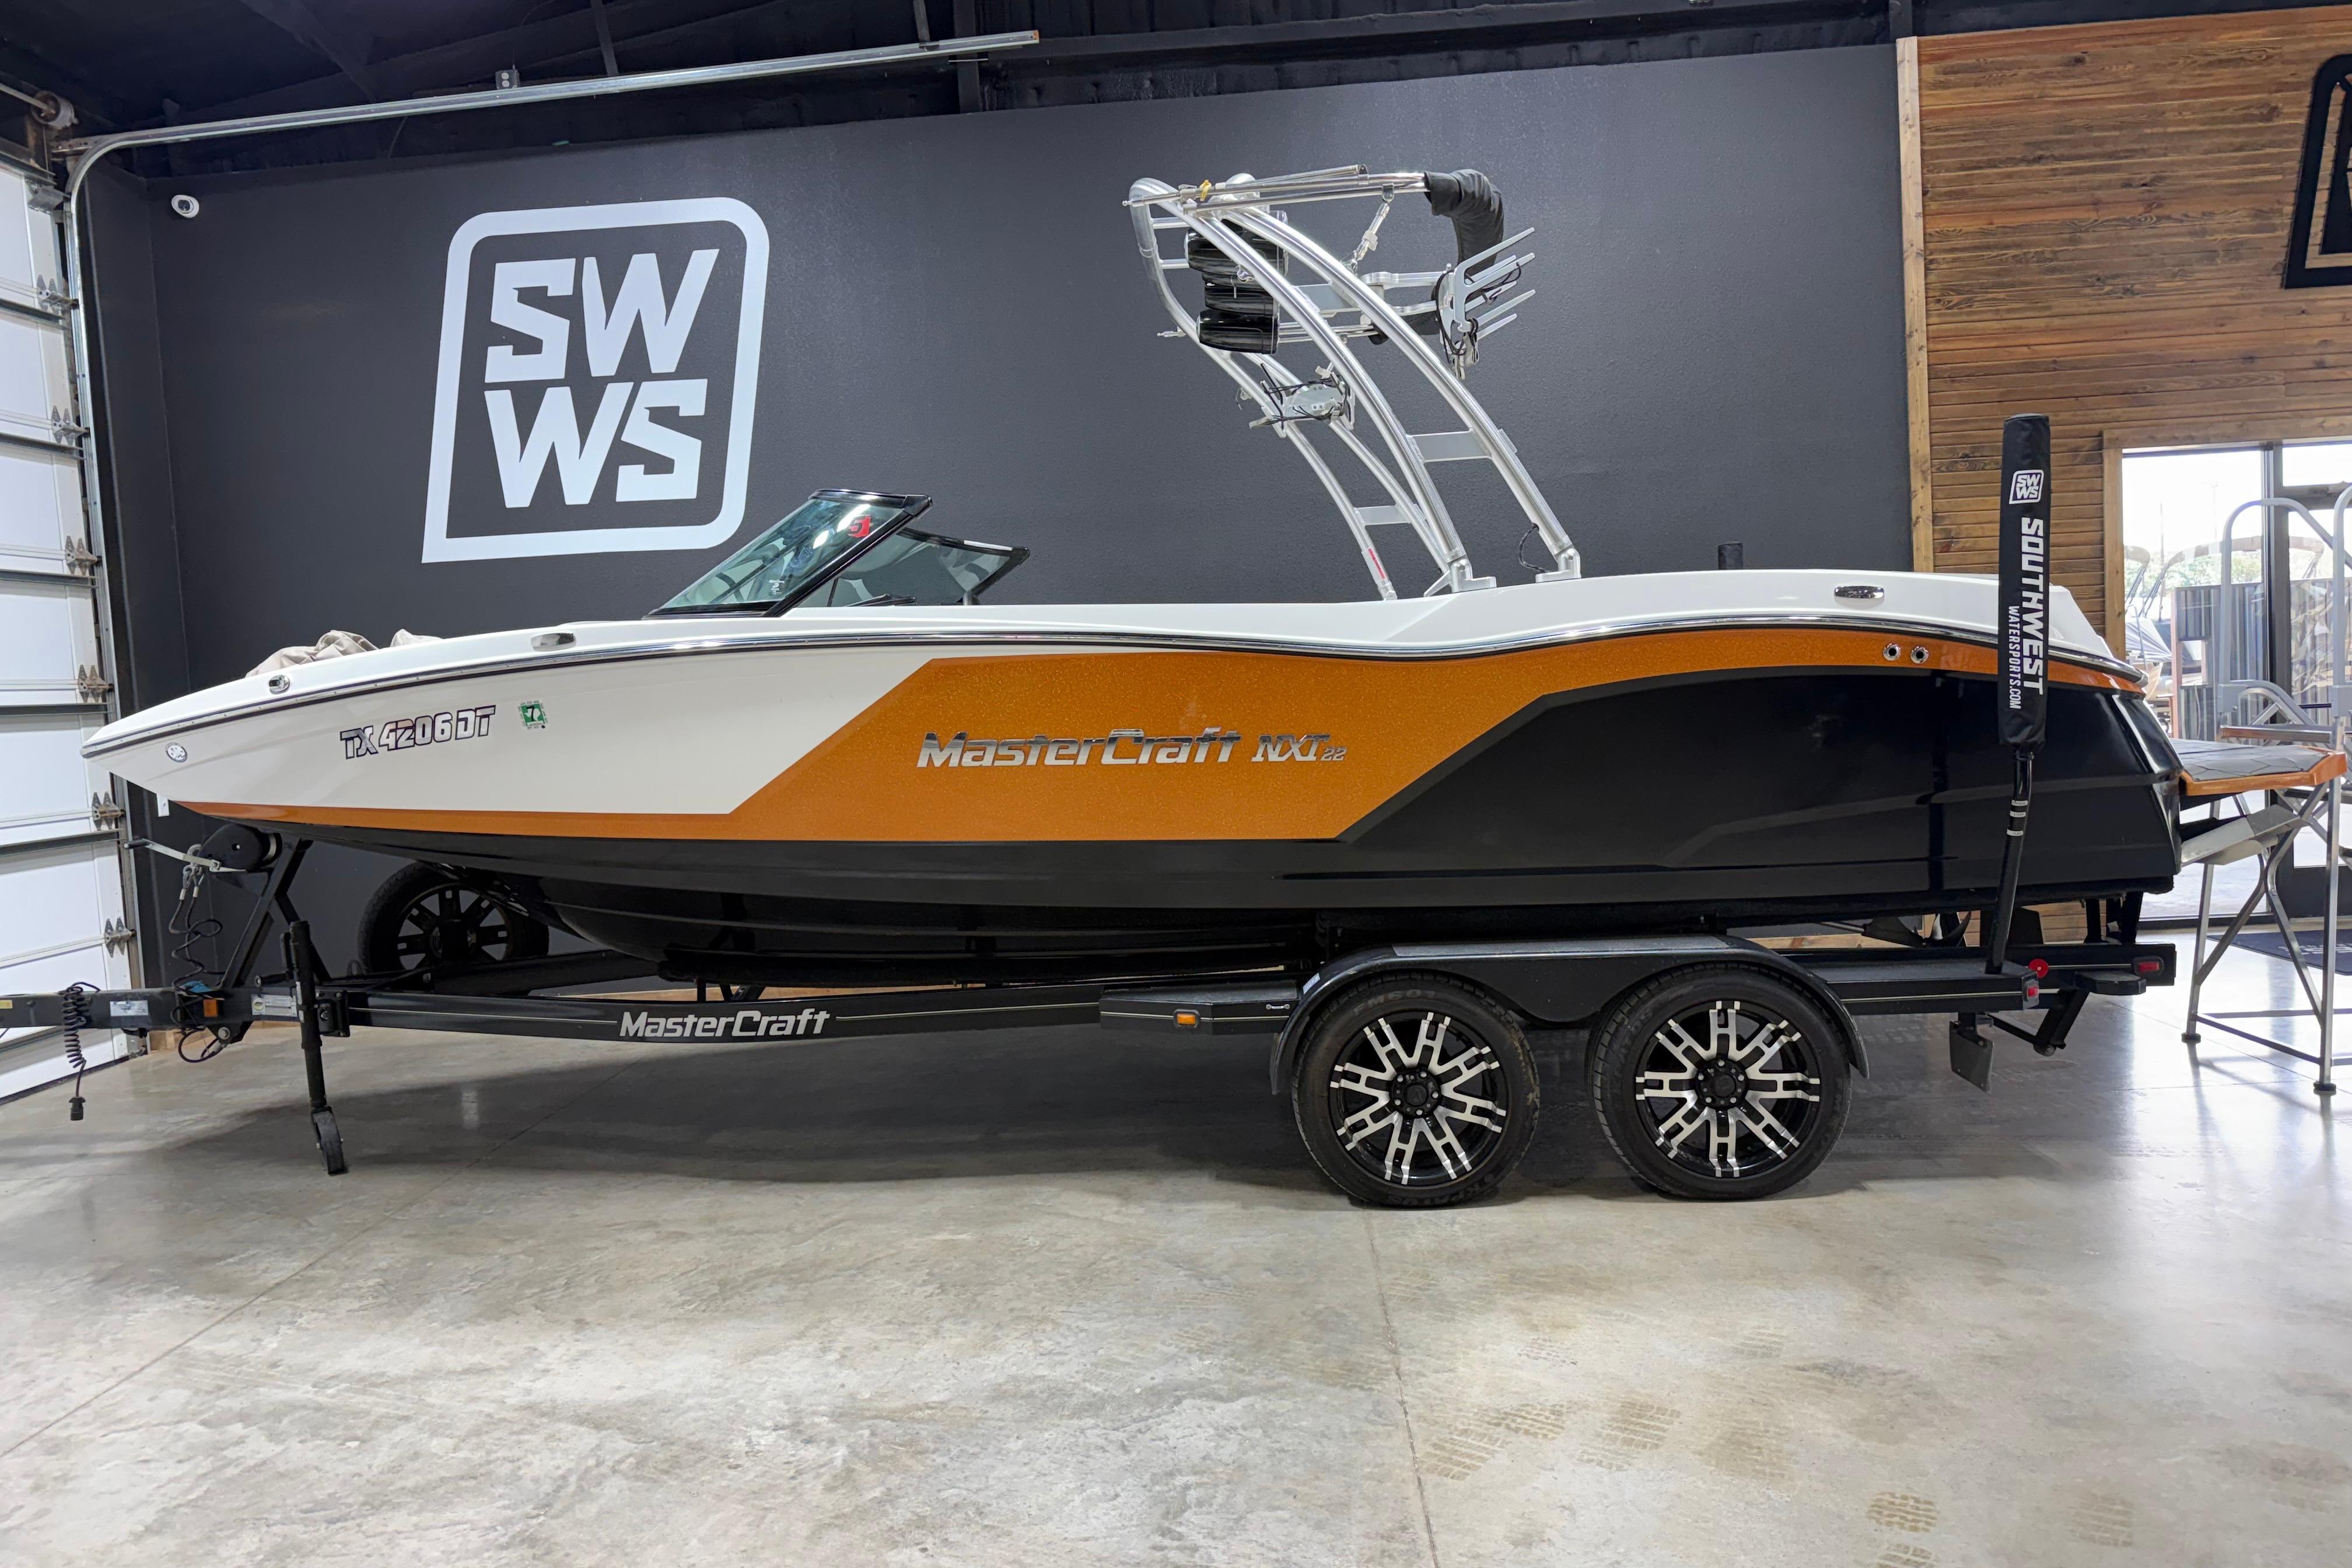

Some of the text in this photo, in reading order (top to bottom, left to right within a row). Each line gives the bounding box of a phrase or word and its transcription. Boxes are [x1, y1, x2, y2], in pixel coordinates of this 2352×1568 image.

[484, 249, 720, 383] SW
[484, 379, 708, 508] WS
[2016, 474, 2041, 487] SW
[2016, 485, 2039, 499] WS
[2021, 517, 2043, 695] SOUTHWEST
[2008, 606, 2021, 709] WATERSPORTS.COM
[340, 704, 496, 760] TX 4206 DT
[916, 726, 1242, 768] MasterCraft
[619, 1007, 831, 1037] MasterCraft
